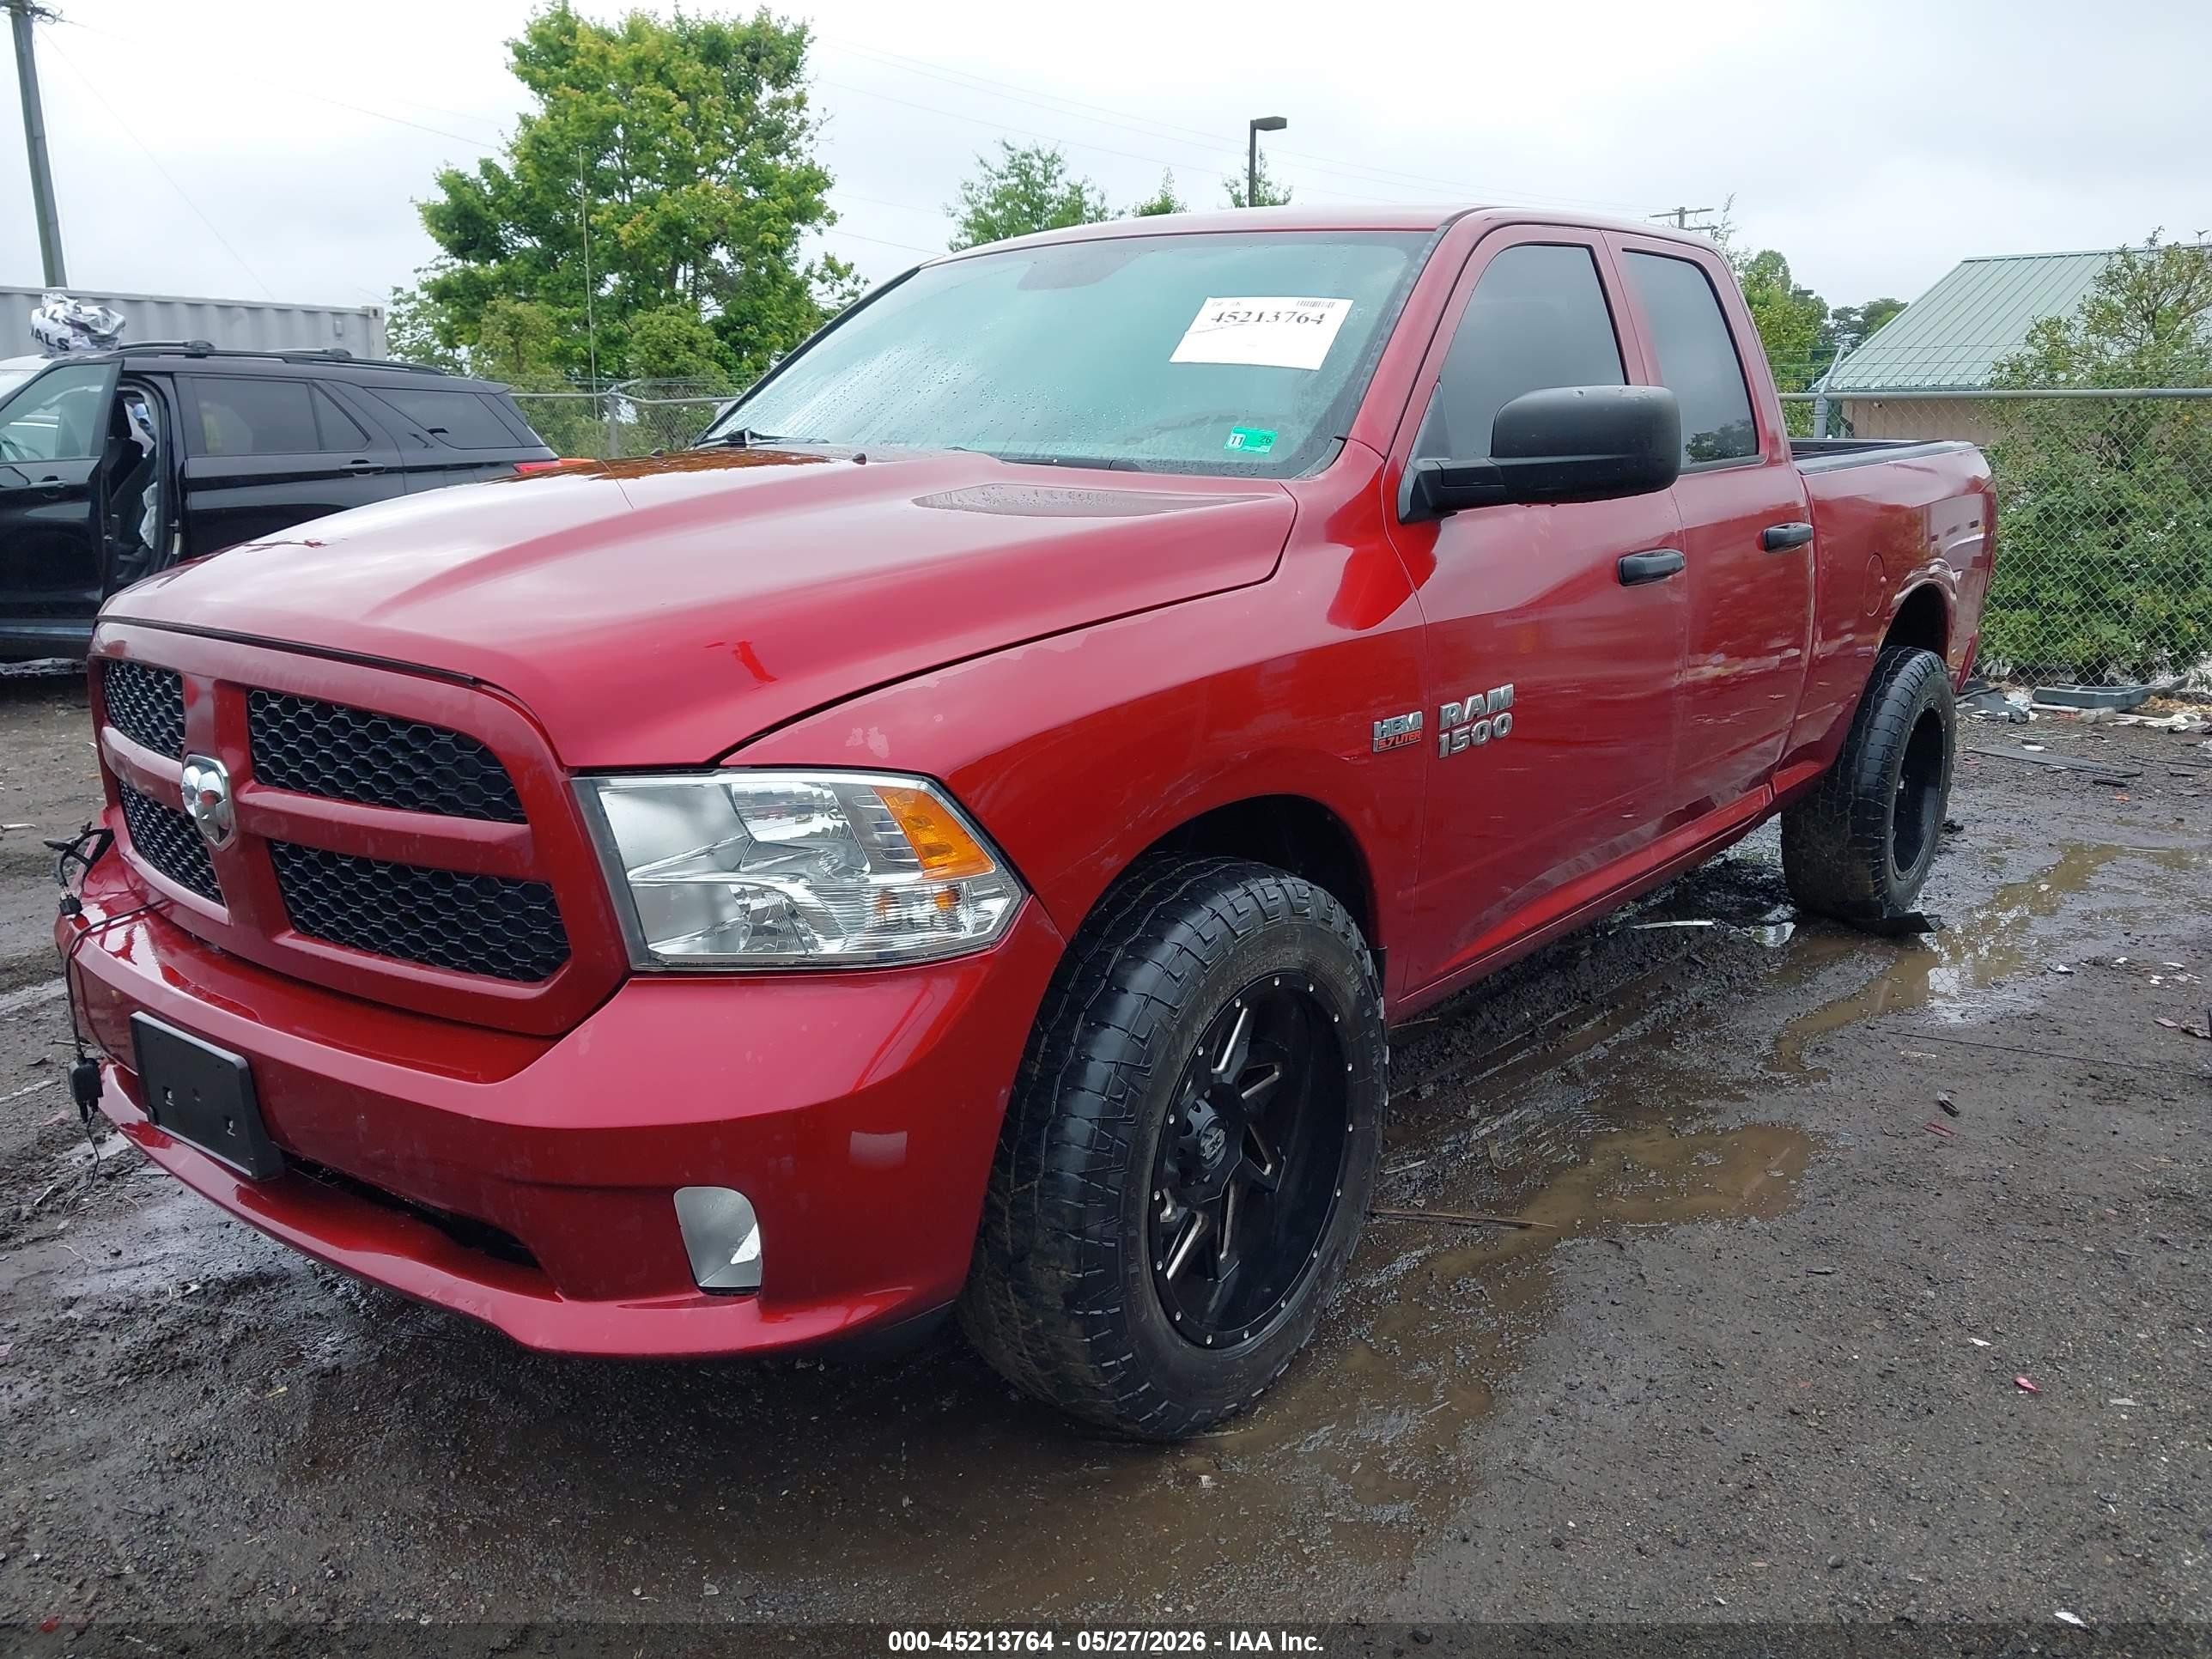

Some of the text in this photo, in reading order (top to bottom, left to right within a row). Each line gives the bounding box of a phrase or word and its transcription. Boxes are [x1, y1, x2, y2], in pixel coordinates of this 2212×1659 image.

[1211, 311, 1326, 325] 45213764
[1231, 434, 1273, 446] 11 26
[1439, 683, 1514, 730] RAM
[1373, 710, 1423, 738] HEMI
[1438, 712, 1513, 759] 1500
[1377, 732, 1422, 750] 5.7 LITER
